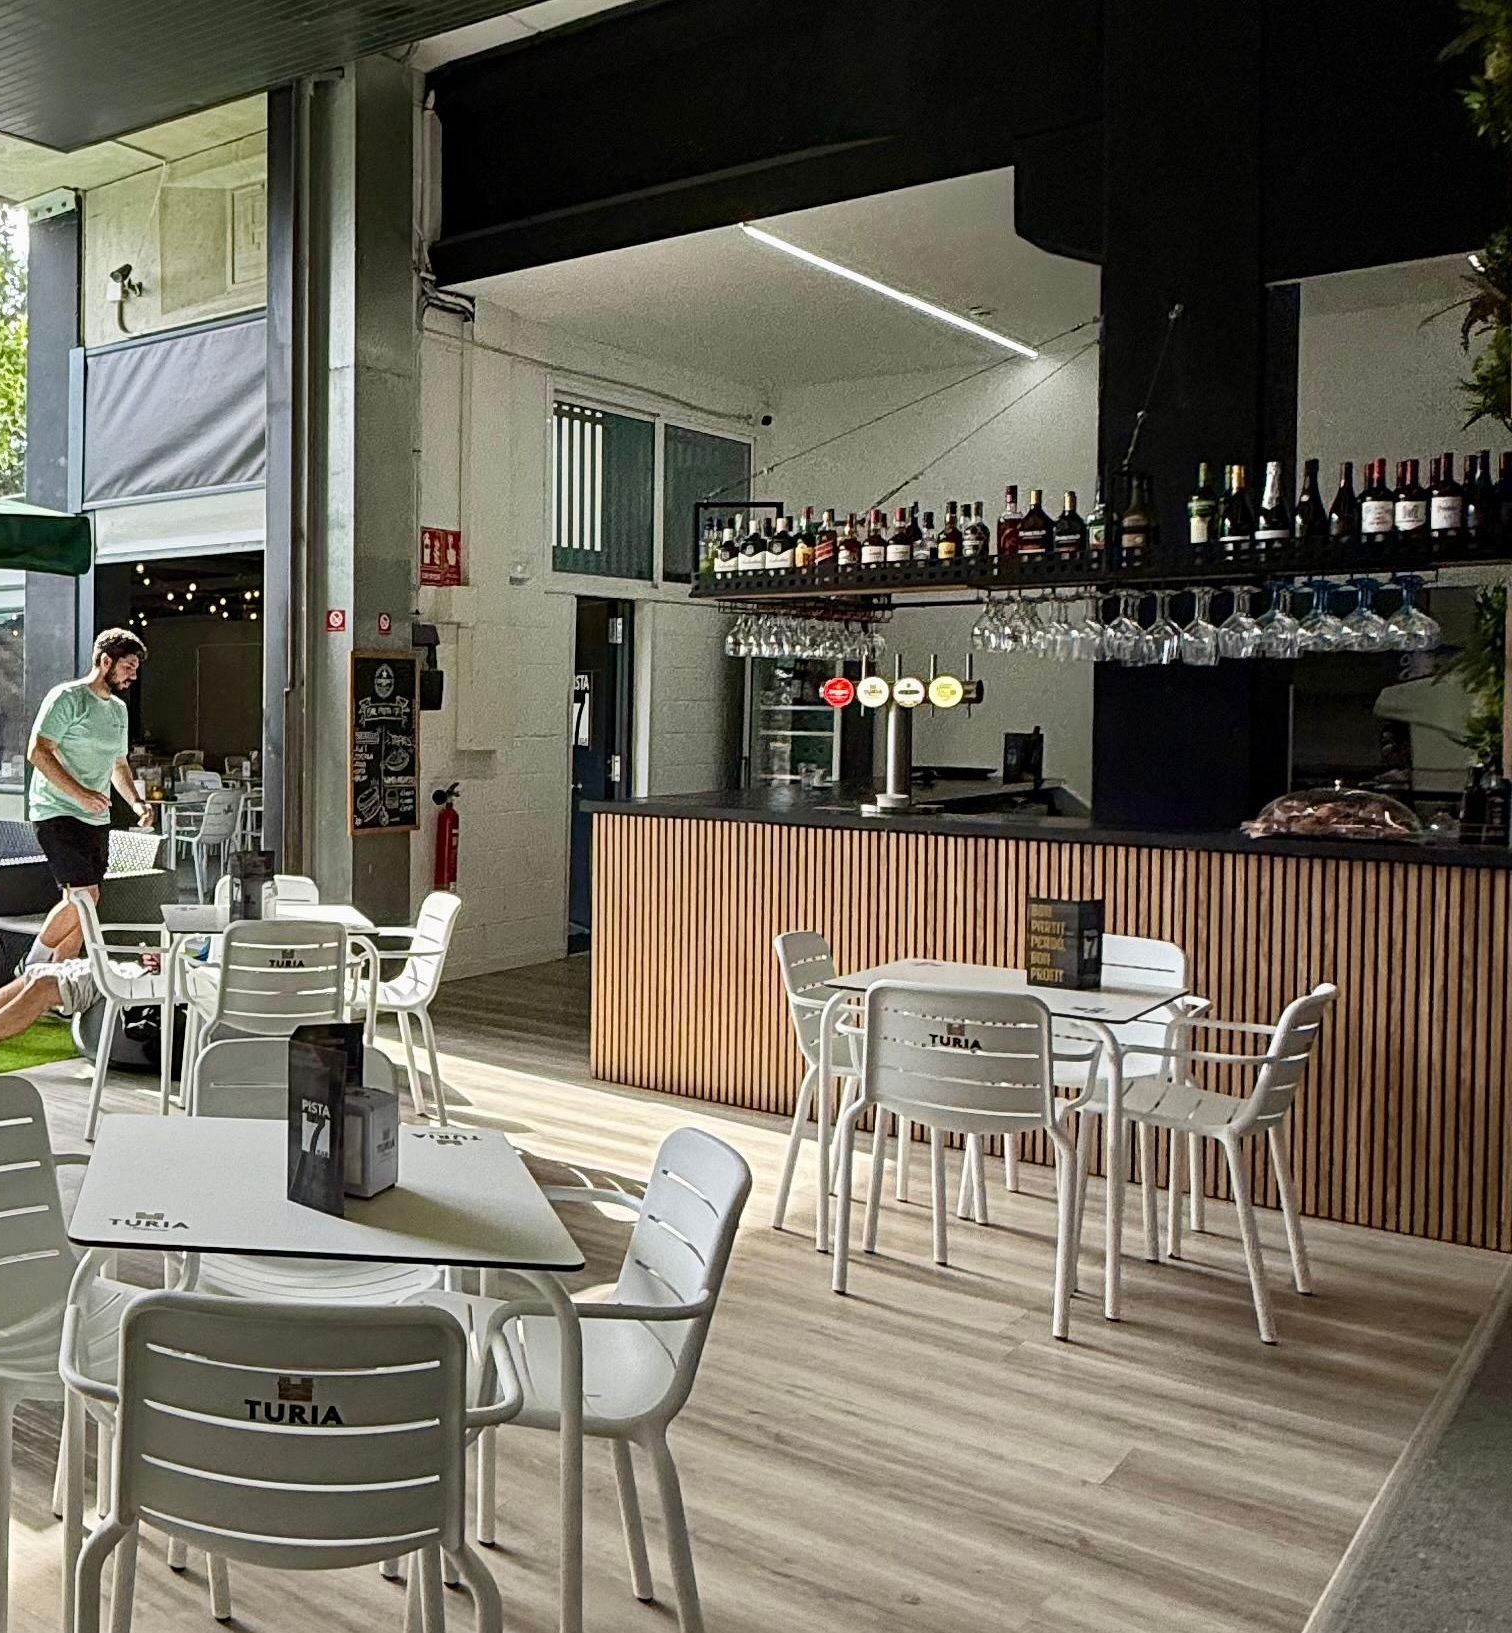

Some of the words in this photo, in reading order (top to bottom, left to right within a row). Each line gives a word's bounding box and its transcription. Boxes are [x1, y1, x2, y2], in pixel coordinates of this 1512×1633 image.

[575, 675, 589, 690] STA
[269, 959, 305, 968] TURIA
[929, 1033, 983, 1050] TURIA
[302, 1099, 330, 1118] PISTA
[306, 1112, 327, 1156] 7
[108, 1218, 189, 1229] TURIA
[244, 1398, 343, 1425] TURIA
